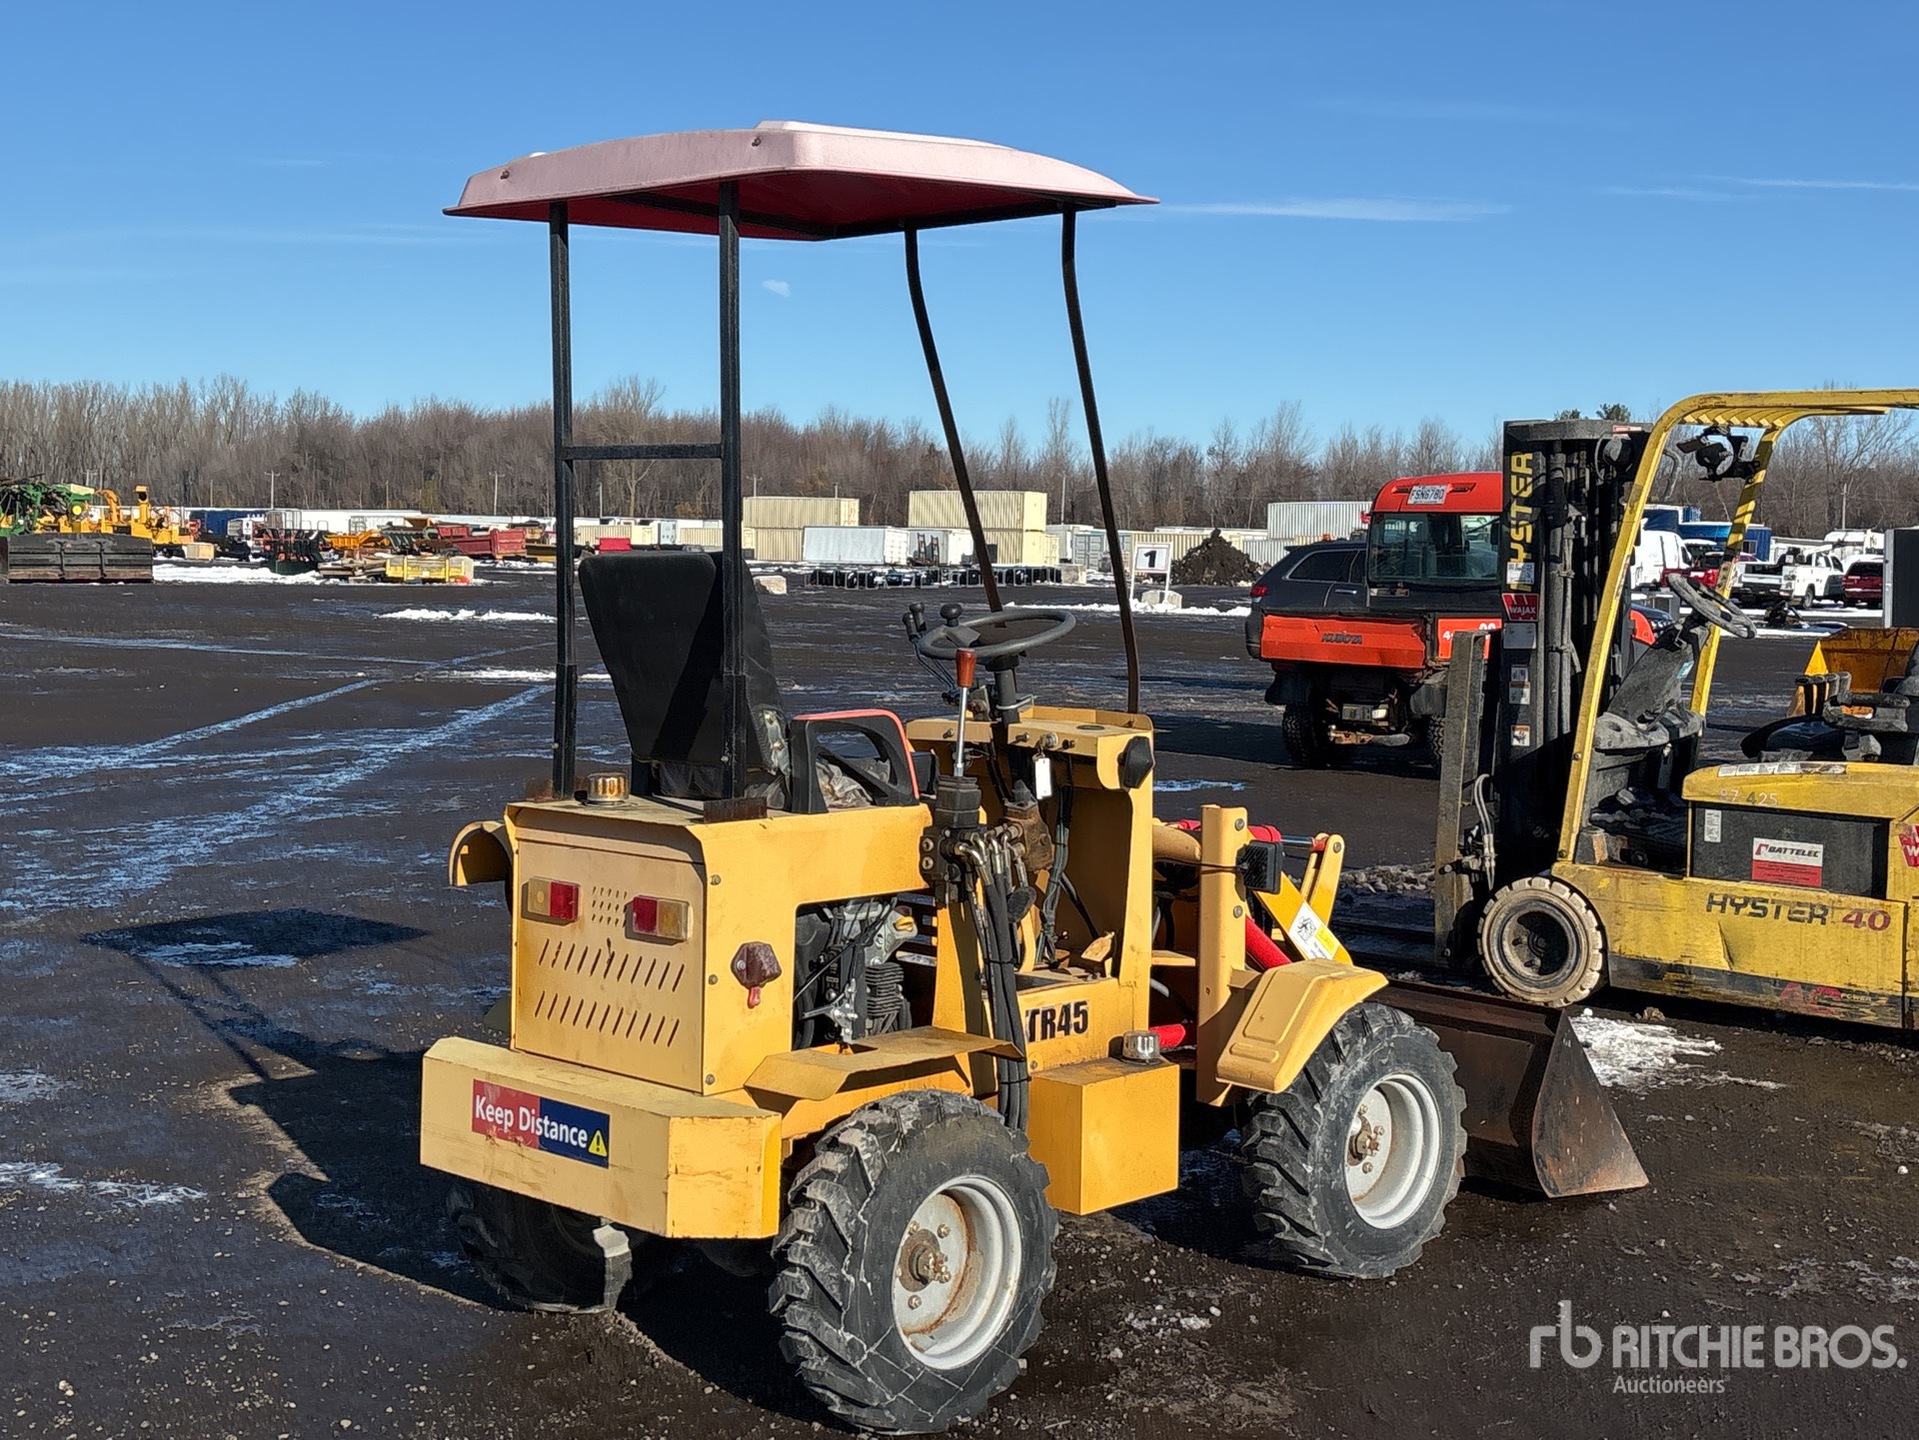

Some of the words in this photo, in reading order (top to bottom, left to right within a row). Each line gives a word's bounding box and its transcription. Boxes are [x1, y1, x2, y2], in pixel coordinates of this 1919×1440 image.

[1144, 550, 1157, 568] 1
[1509, 605, 1536, 615] WAJAX
[1321, 632, 1363, 645] KUBOTA
[1768, 846, 1821, 858] BATTELEC
[1706, 892, 1828, 926] HYSTER
[1842, 908, 1891, 932] 40
[1025, 1000, 1089, 1043] TR45
[474, 1094, 514, 1133] Keep
[518, 1106, 588, 1149] Distance
